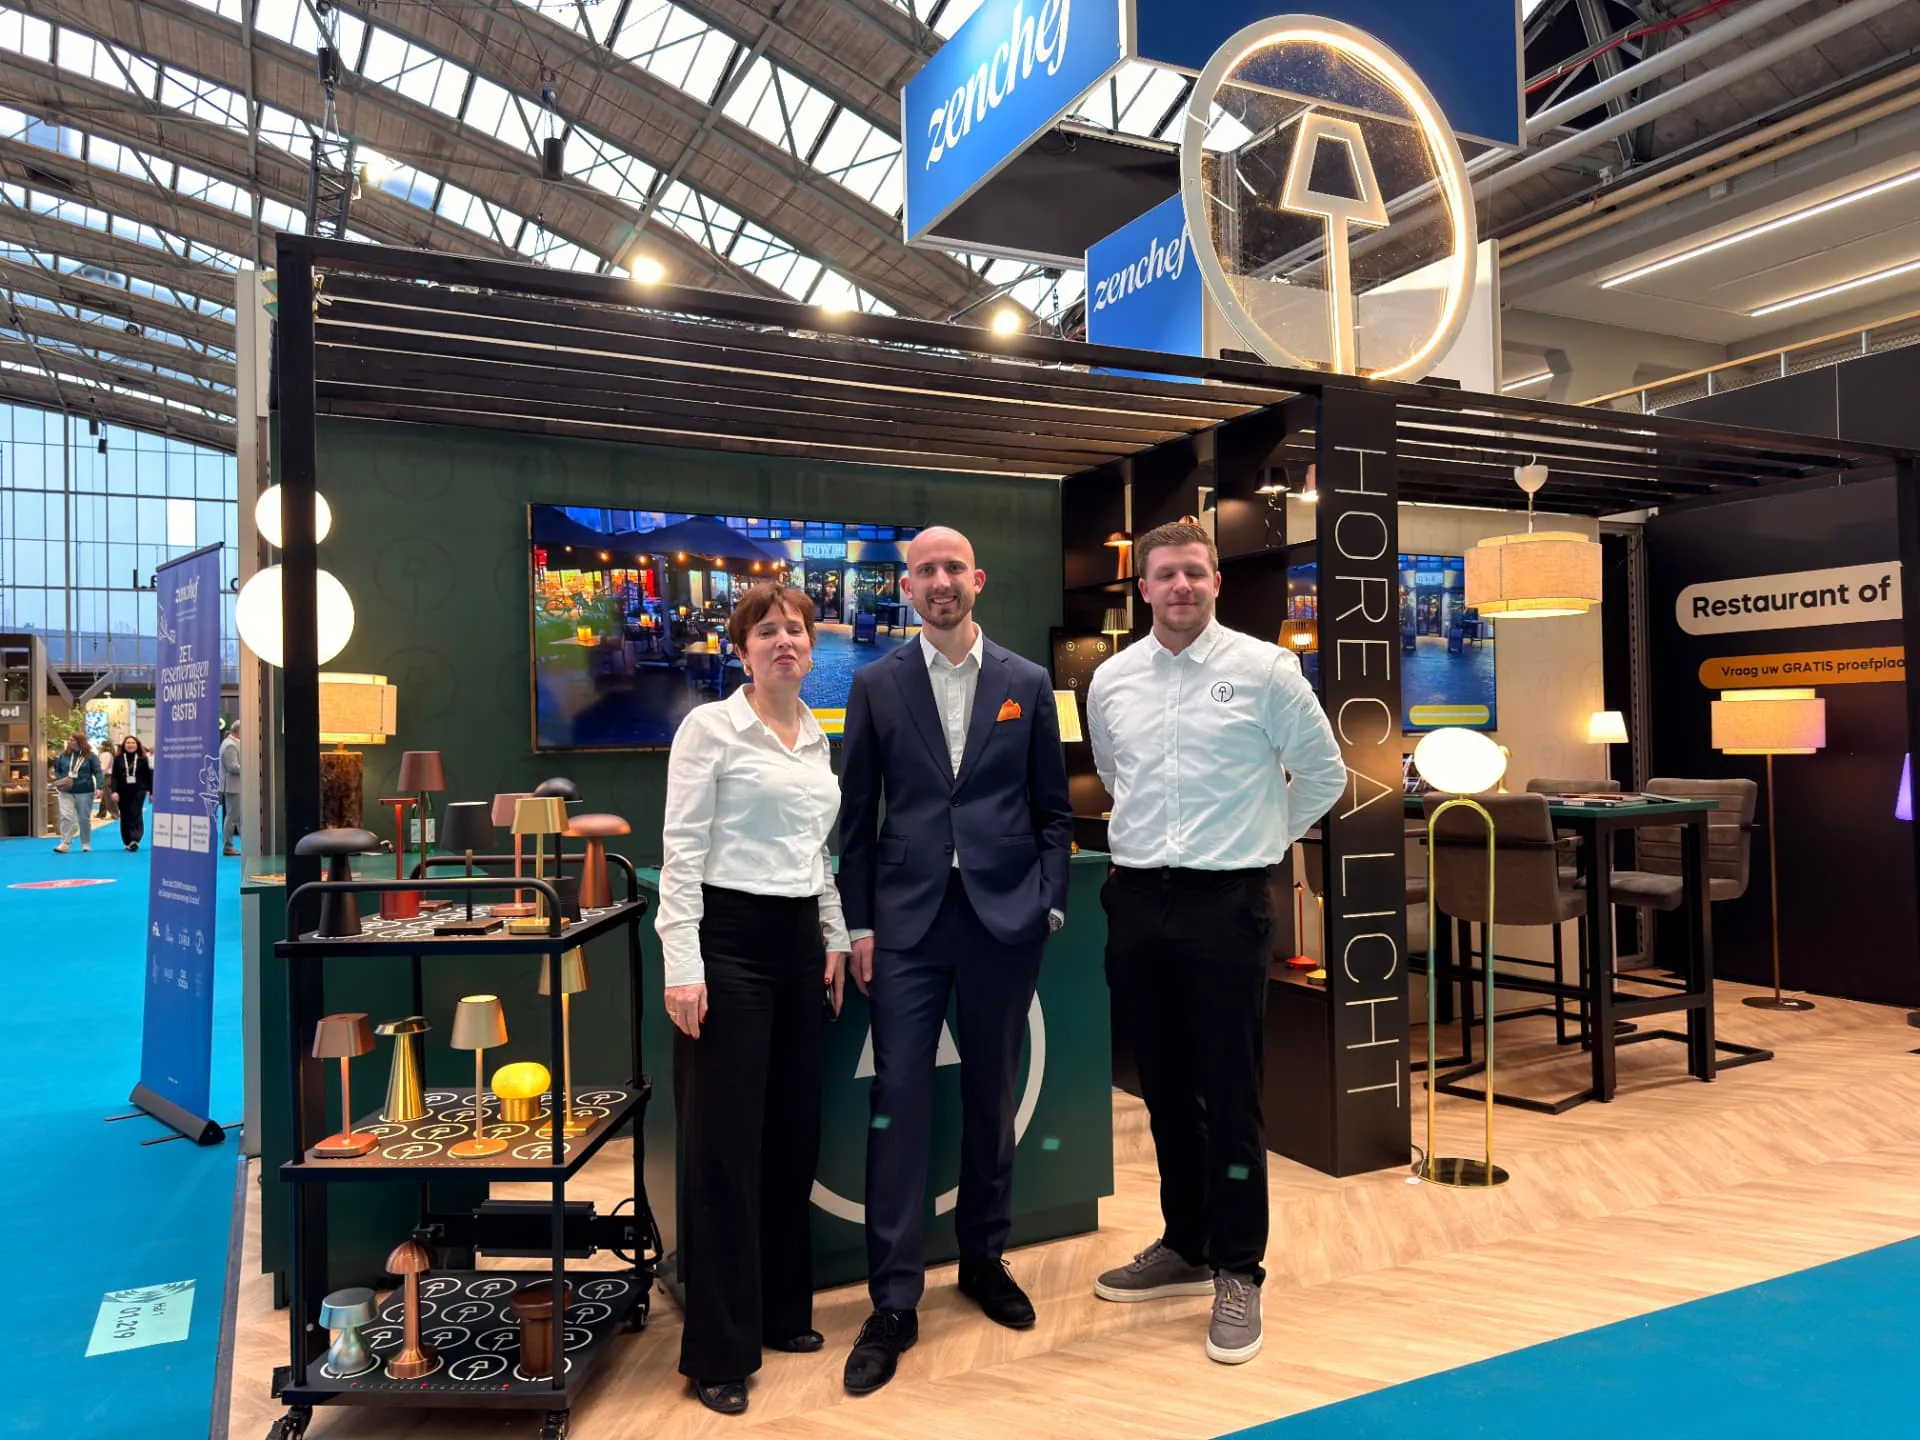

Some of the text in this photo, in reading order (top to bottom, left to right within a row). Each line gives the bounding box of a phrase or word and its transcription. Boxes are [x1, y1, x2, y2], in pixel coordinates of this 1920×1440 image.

[1093, 220, 1188, 313] zenchef
[1692, 575, 1892, 618] Restaurant of
[1721, 666, 1758, 678] Vraag
[1761, 664, 1779, 675] uw
[1782, 661, 1833, 674] GRATIS
[172, 702, 197, 721] GASTEN
[1334, 446, 1400, 1108] HORECA LICHT
